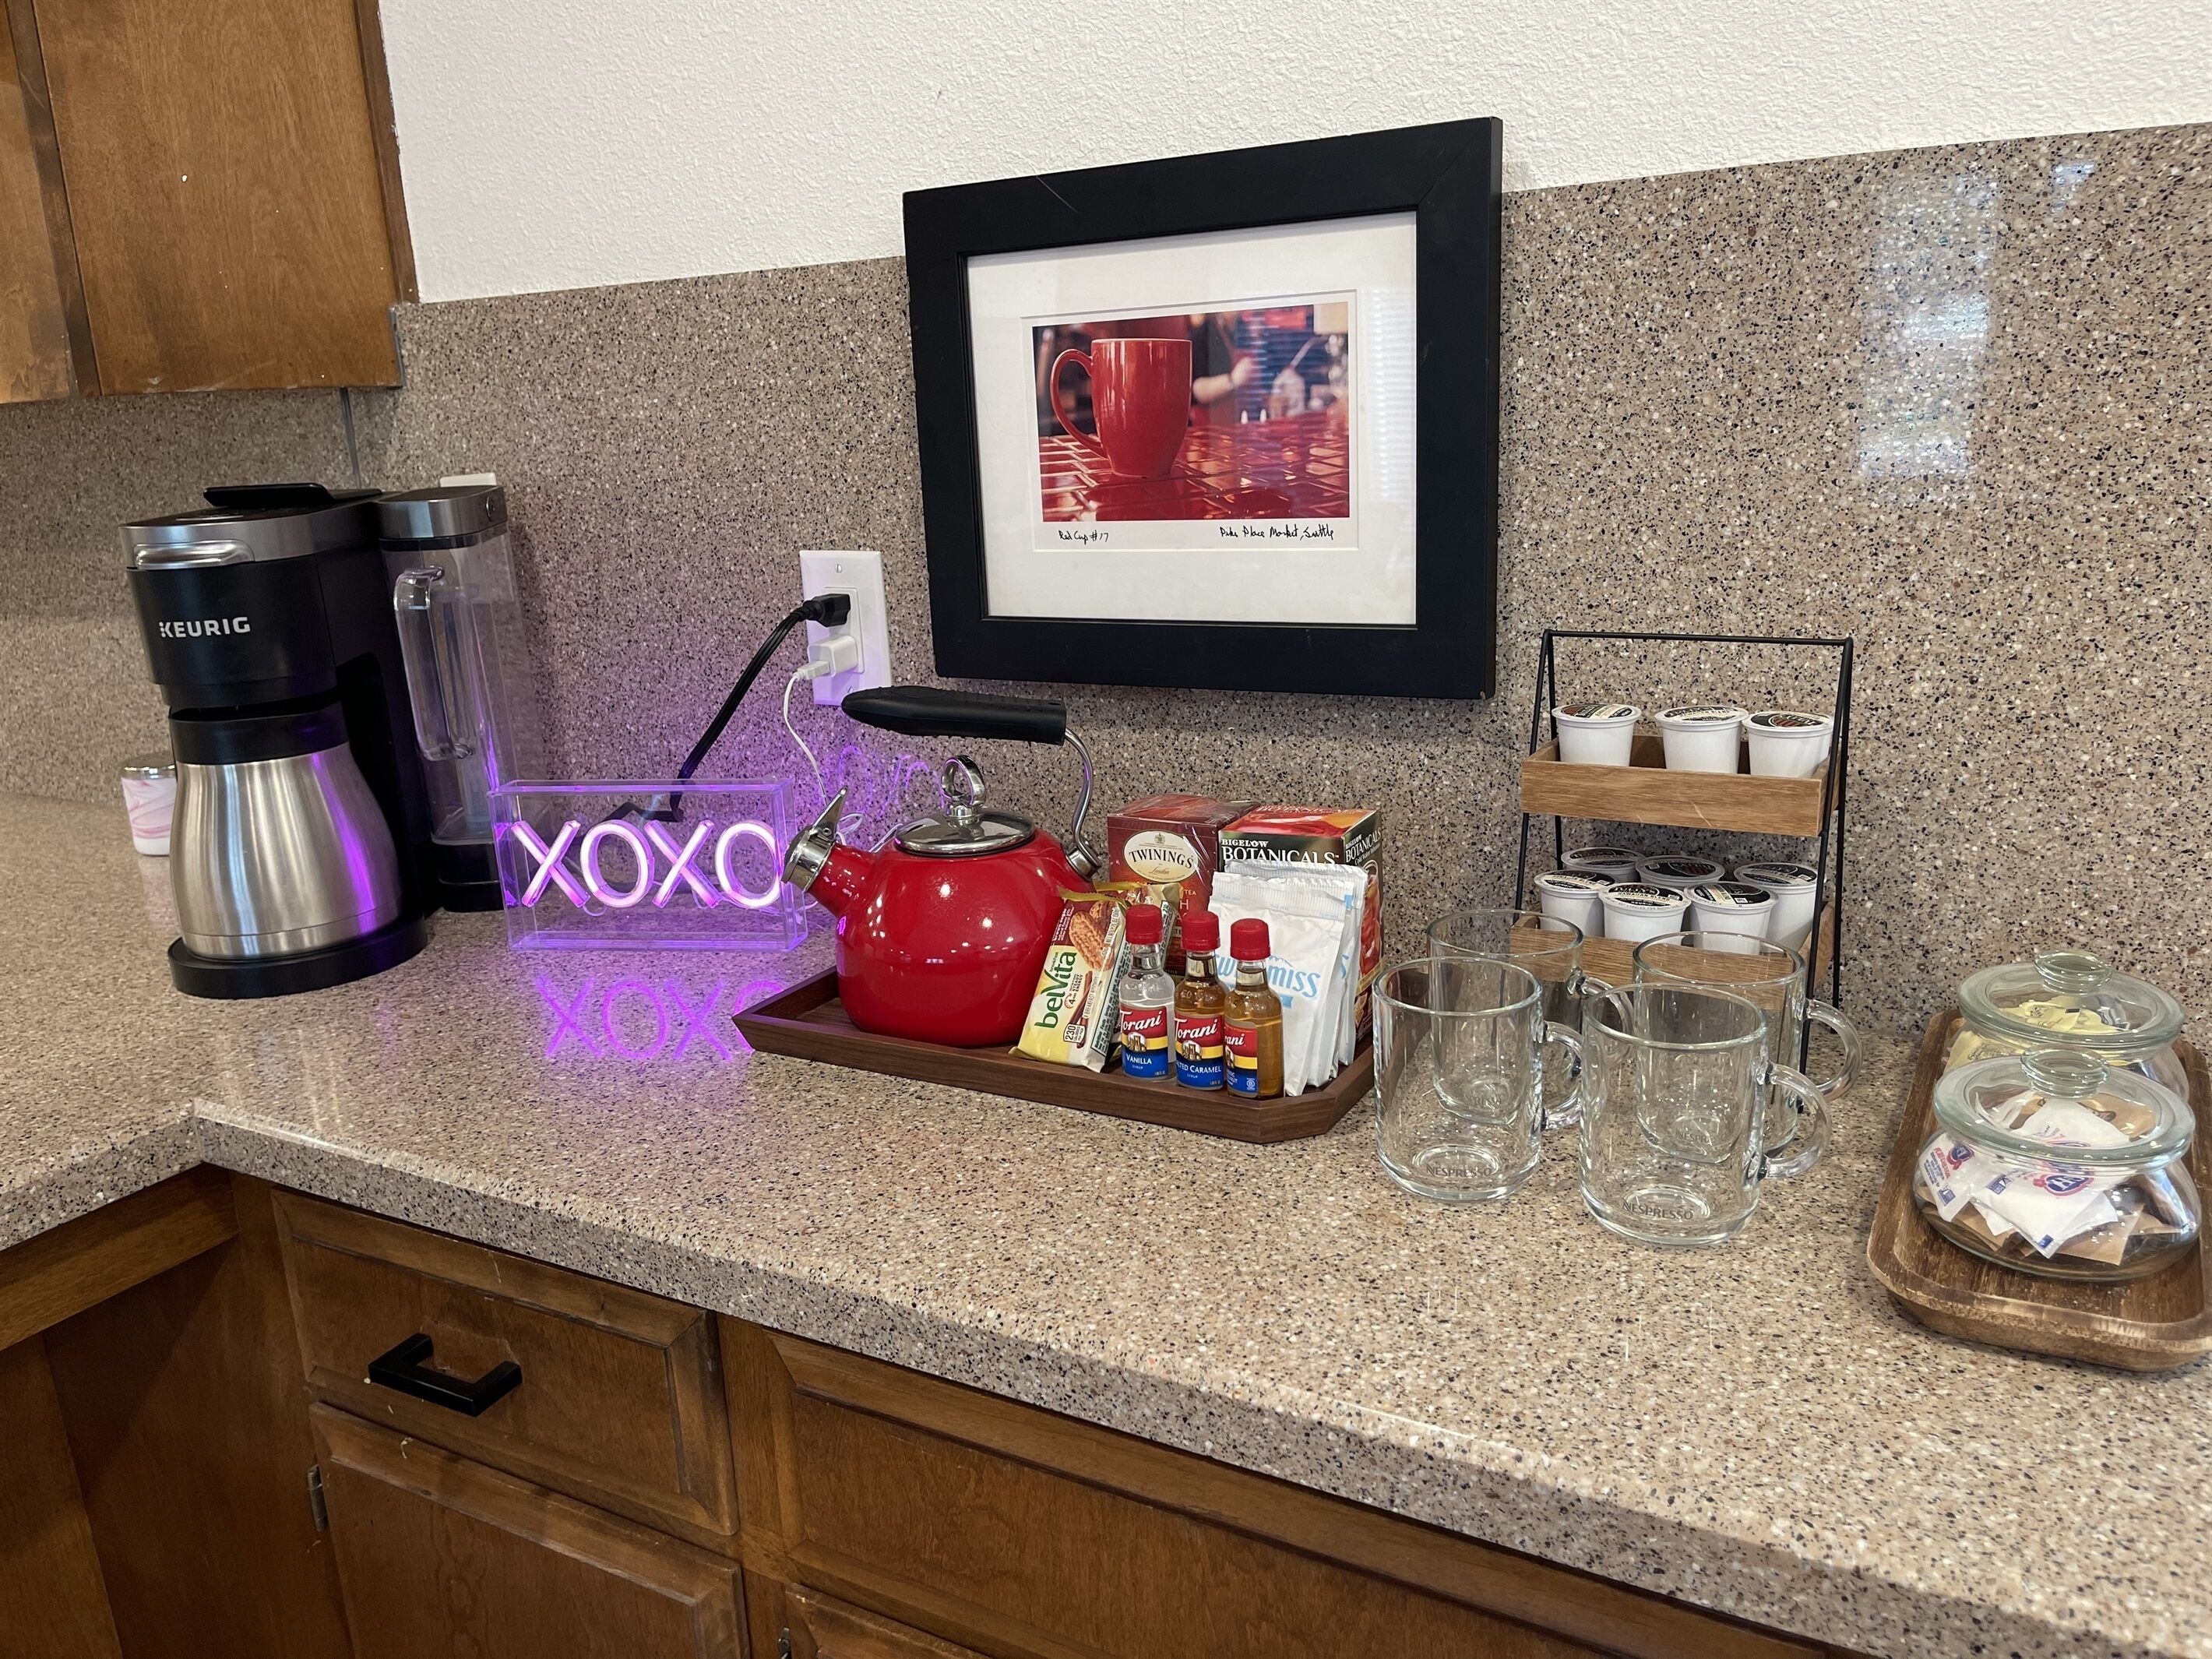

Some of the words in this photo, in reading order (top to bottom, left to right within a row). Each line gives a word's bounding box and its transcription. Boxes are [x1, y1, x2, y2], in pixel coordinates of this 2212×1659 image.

[1058, 530, 1073, 541] Red
[1074, 530, 1088, 545] Cup
[1242, 524, 1265, 538] Place
[159, 616, 251, 638] KEURIG
[1222, 839, 1269, 847] BIGELOW
[1346, 826, 1382, 863] BOTANICALS
[511, 819, 782, 909] XOXO
[1129, 848, 1194, 868] TWININGS
[1222, 846, 1337, 865] BOTANICALS
[1034, 952, 1077, 1029] belVita
[1119, 1010, 1163, 1032] Torani
[1174, 1017, 1218, 1041] Torani
[1064, 1023, 1076, 1041] 230
[1224, 1033, 1245, 1046] rani
[1126, 1054, 1152, 1065] VANILLA
[1177, 1062, 1189, 1071] LTED
[1190, 1065, 1221, 1073] CARAMEL
[1426, 1164, 1492, 1177] NESPRESSO
[1622, 1198, 1694, 1220] NESPRESSO
